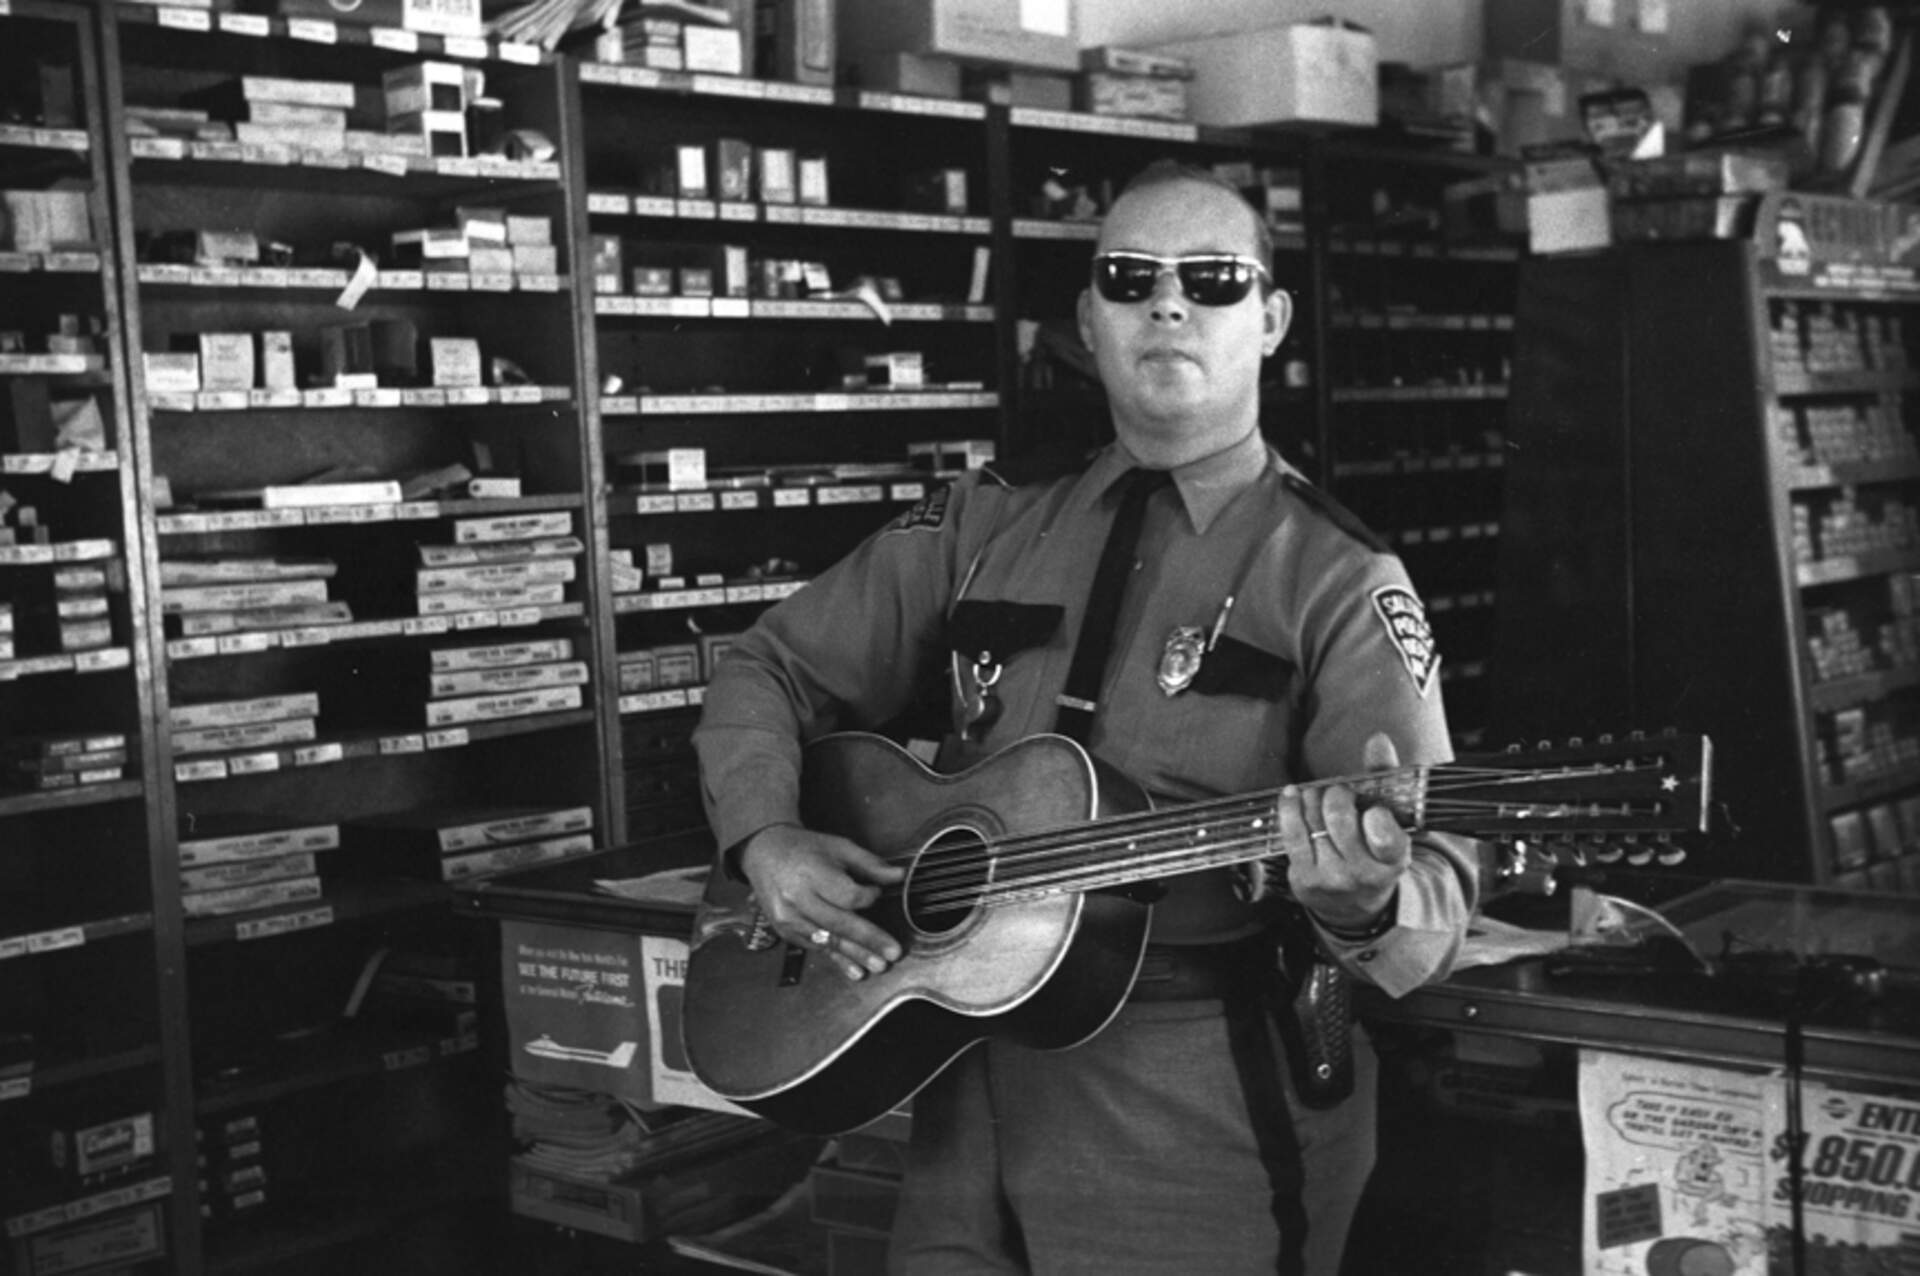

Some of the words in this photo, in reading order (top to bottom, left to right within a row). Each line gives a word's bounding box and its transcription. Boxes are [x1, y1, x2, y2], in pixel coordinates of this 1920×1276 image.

[538, 964, 558, 979] THE
[560, 966, 598, 985] FUTURE
[601, 971, 631, 988] FIRST
[652, 957, 688, 978] THE
[1644, 1112, 1666, 1124] THE
